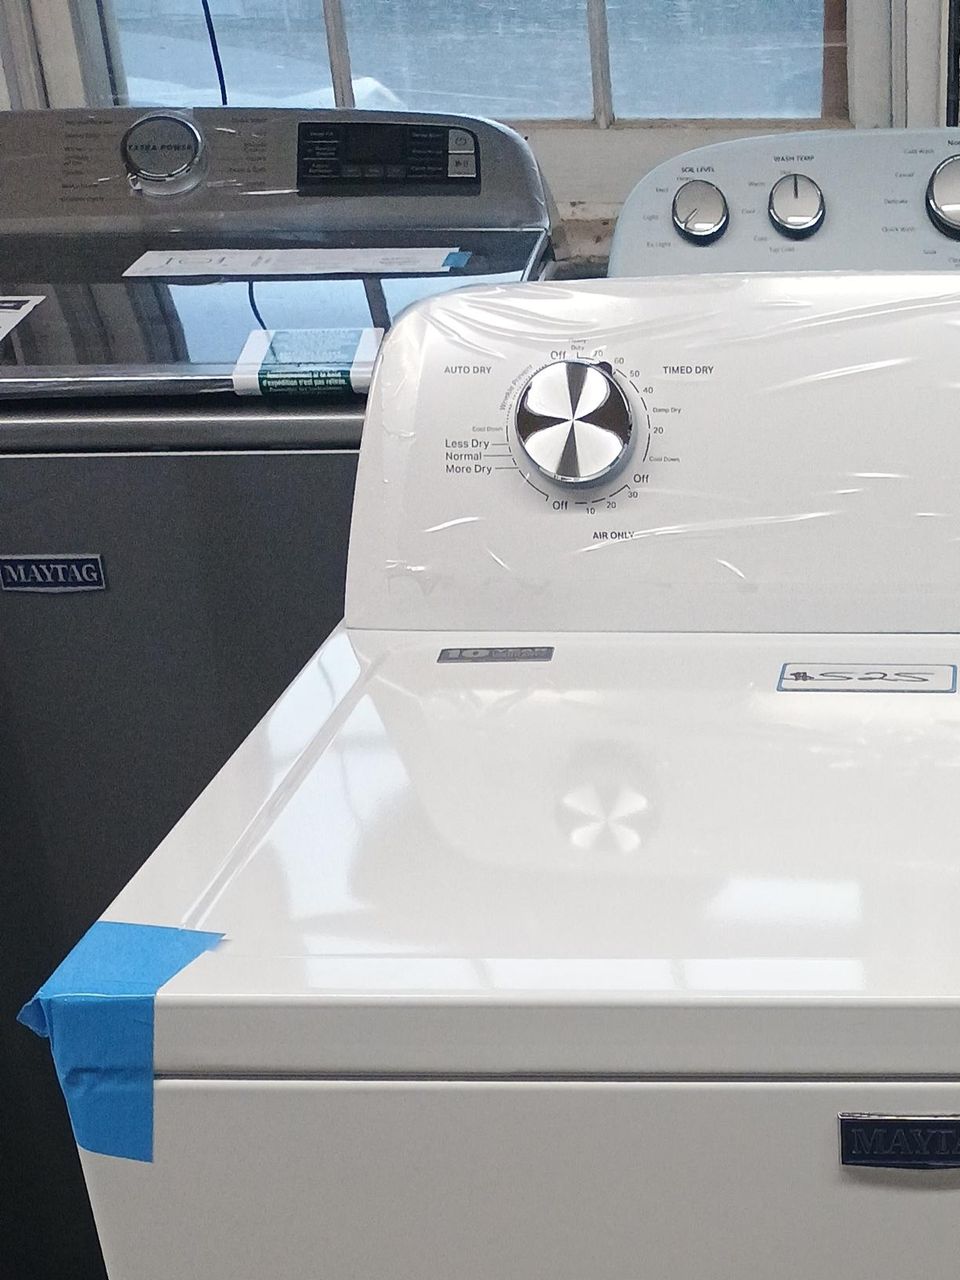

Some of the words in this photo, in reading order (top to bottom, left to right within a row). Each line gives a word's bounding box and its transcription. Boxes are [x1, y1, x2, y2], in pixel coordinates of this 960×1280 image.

[681, 166, 696, 174] SOIL
[550, 350, 567, 361] Off
[444, 366, 472, 375] AUTO
[474, 366, 493, 375] DRY
[629, 370, 641, 378] 50
[662, 365, 693, 376] TIMED
[694, 365, 715, 376] DRY
[642, 386, 654, 395] 40
[652, 407, 669, 415] Damp
[670, 407, 683, 415] Dry
[653, 426, 665, 435] 20
[445, 438, 467, 449] Less
[469, 438, 490, 450] Dry
[445, 451, 483, 462] Normal
[445, 463, 472, 474] More
[473, 463, 493, 476] Dry
[633, 472, 650, 484] Off
[627, 490, 639, 500] 30
[552, 500, 569, 512] Off
[585, 506, 596, 515] 10
[606, 501, 617, 510] 20
[592, 530, 609, 541] AIR
[610, 530, 635, 541] ONLY
[2, 563, 99, 585] MAYTAG
